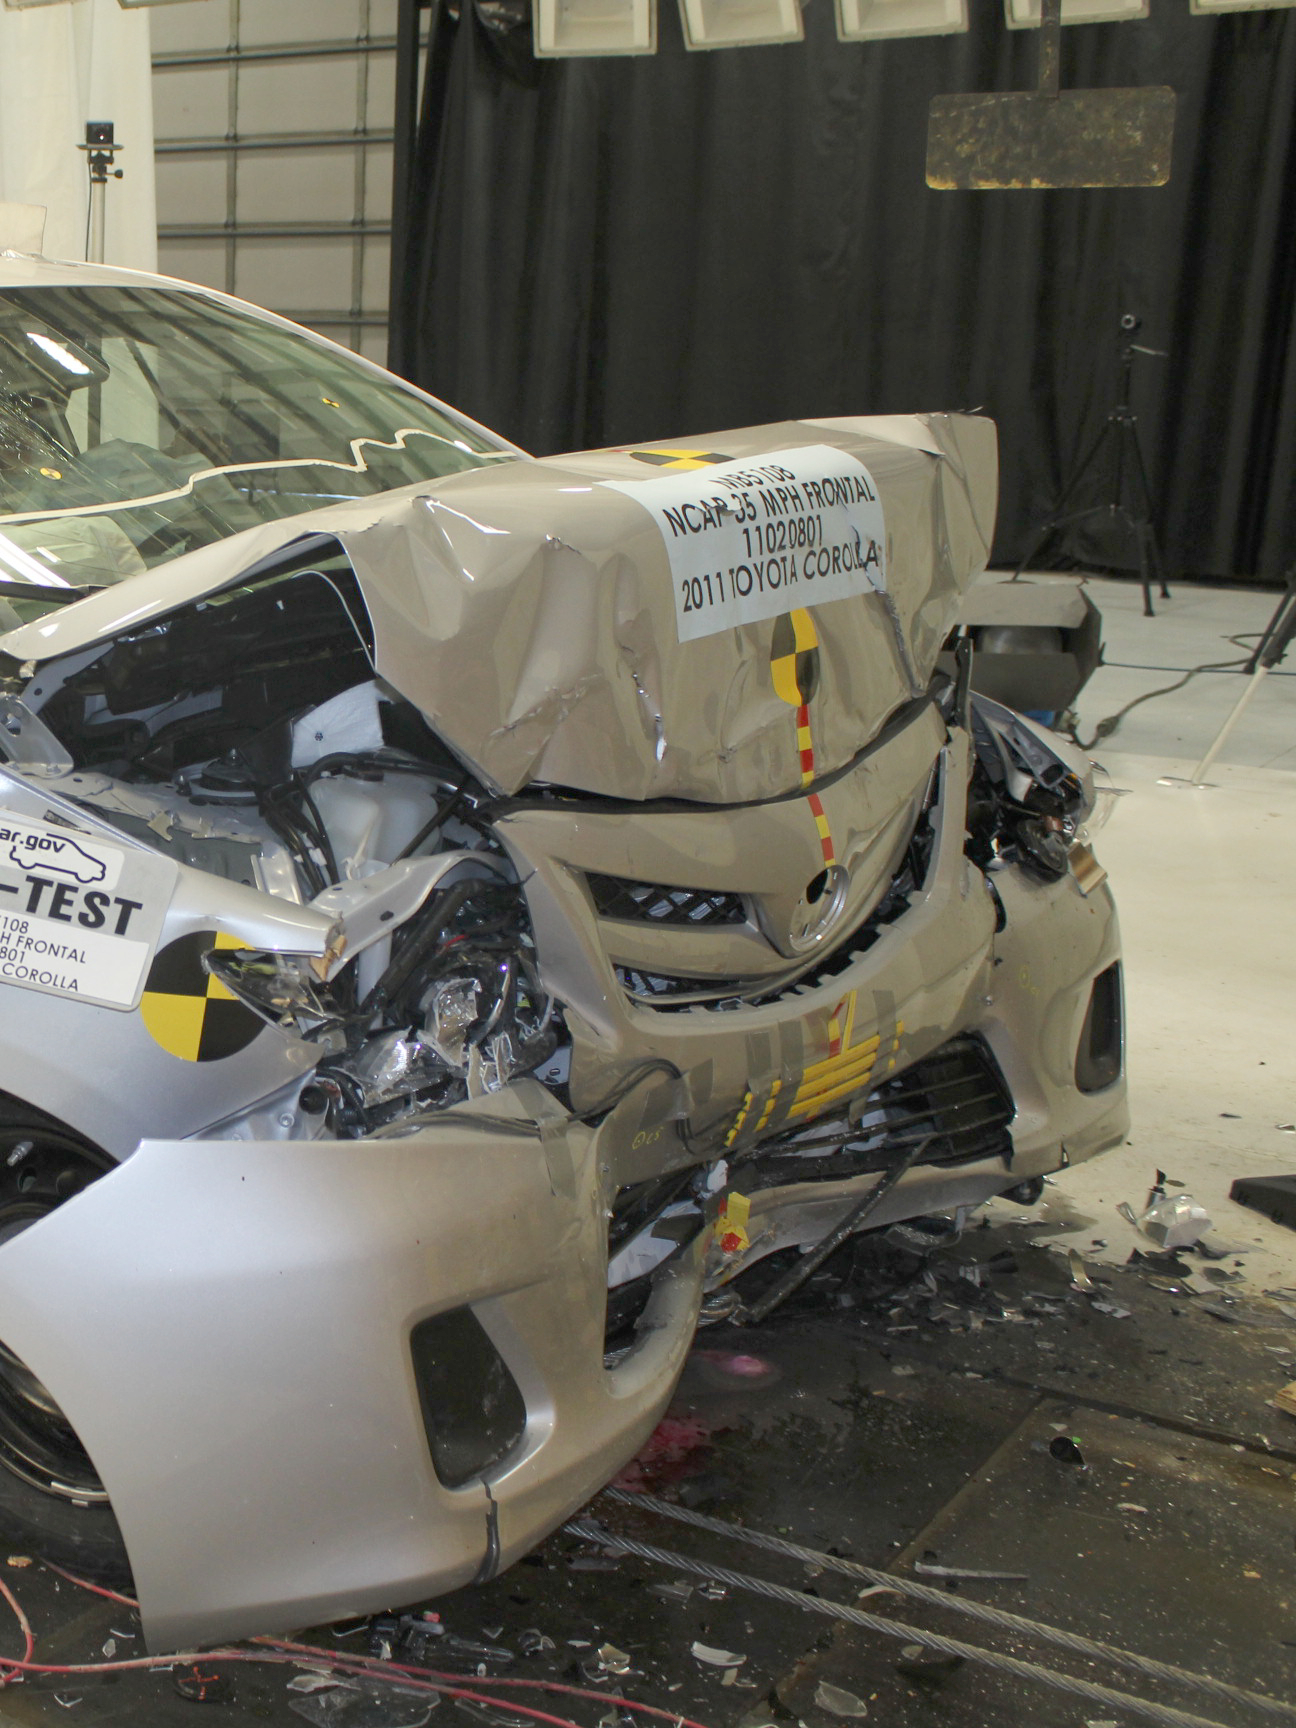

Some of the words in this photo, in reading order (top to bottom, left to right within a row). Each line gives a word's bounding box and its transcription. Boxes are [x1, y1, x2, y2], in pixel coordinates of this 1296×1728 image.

[709, 465, 795, 490] MB5108
[662, 497, 728, 537] NCAP
[731, 492, 757, 523] 35
[759, 485, 804, 517] MPH
[802, 476, 875, 510] FRONTAL
[743, 515, 822, 558] 11020801
[682, 572, 724, 612] 2011
[729, 554, 798, 598] TOYOTA
[804, 539, 878, 579] COROLLA
[16, 935, 86, 964] FRONTAL
[3, 962, 78, 992] COROLLA
